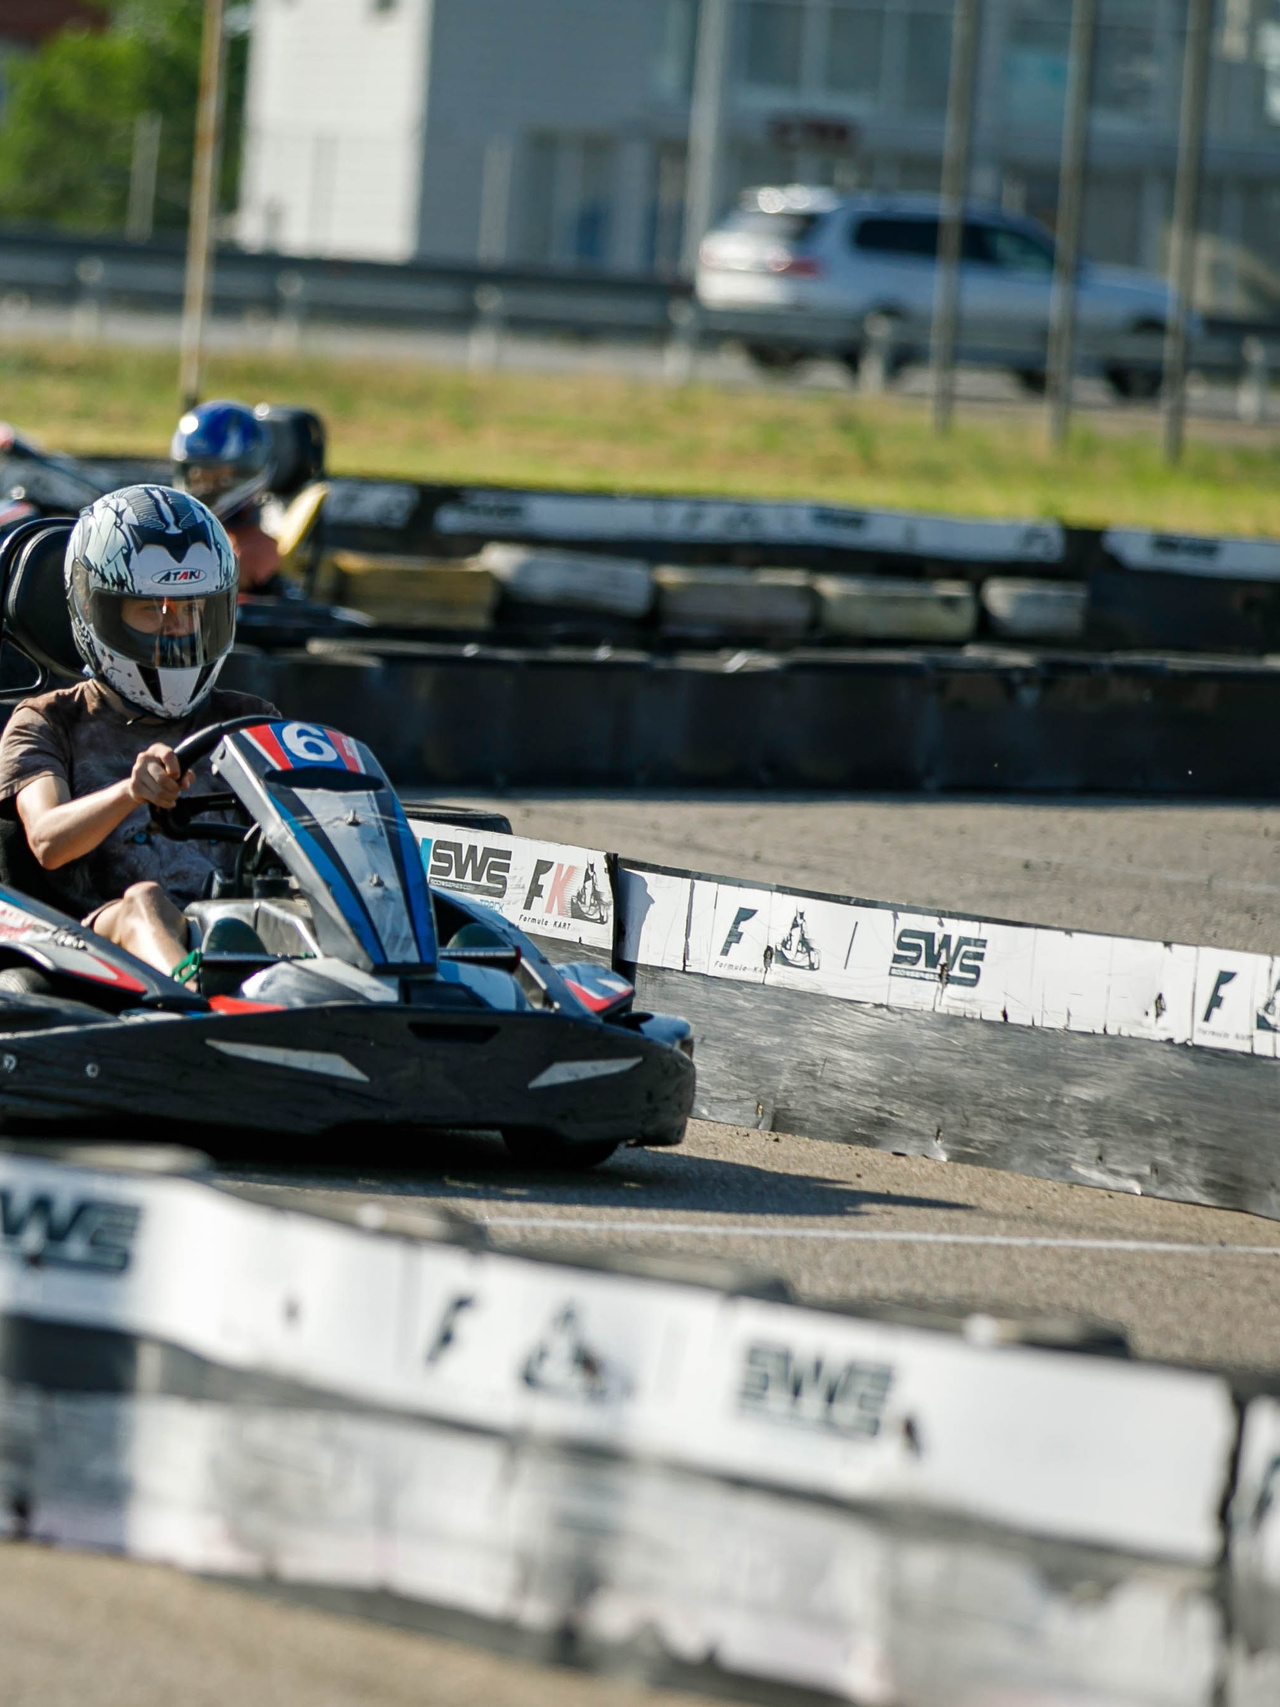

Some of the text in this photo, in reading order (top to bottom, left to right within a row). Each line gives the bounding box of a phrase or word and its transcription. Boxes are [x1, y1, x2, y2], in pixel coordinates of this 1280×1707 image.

[282, 722, 338, 762] 6
[429, 839, 512, 899] SWS
[523, 858, 577, 918] FK
[519, 914, 571, 930] Formule KART
[719, 906, 759, 957] F
[890, 928, 987, 988] SWS
[1202, 969, 1238, 1023] F
[736, 1340, 895, 1441] SWS
